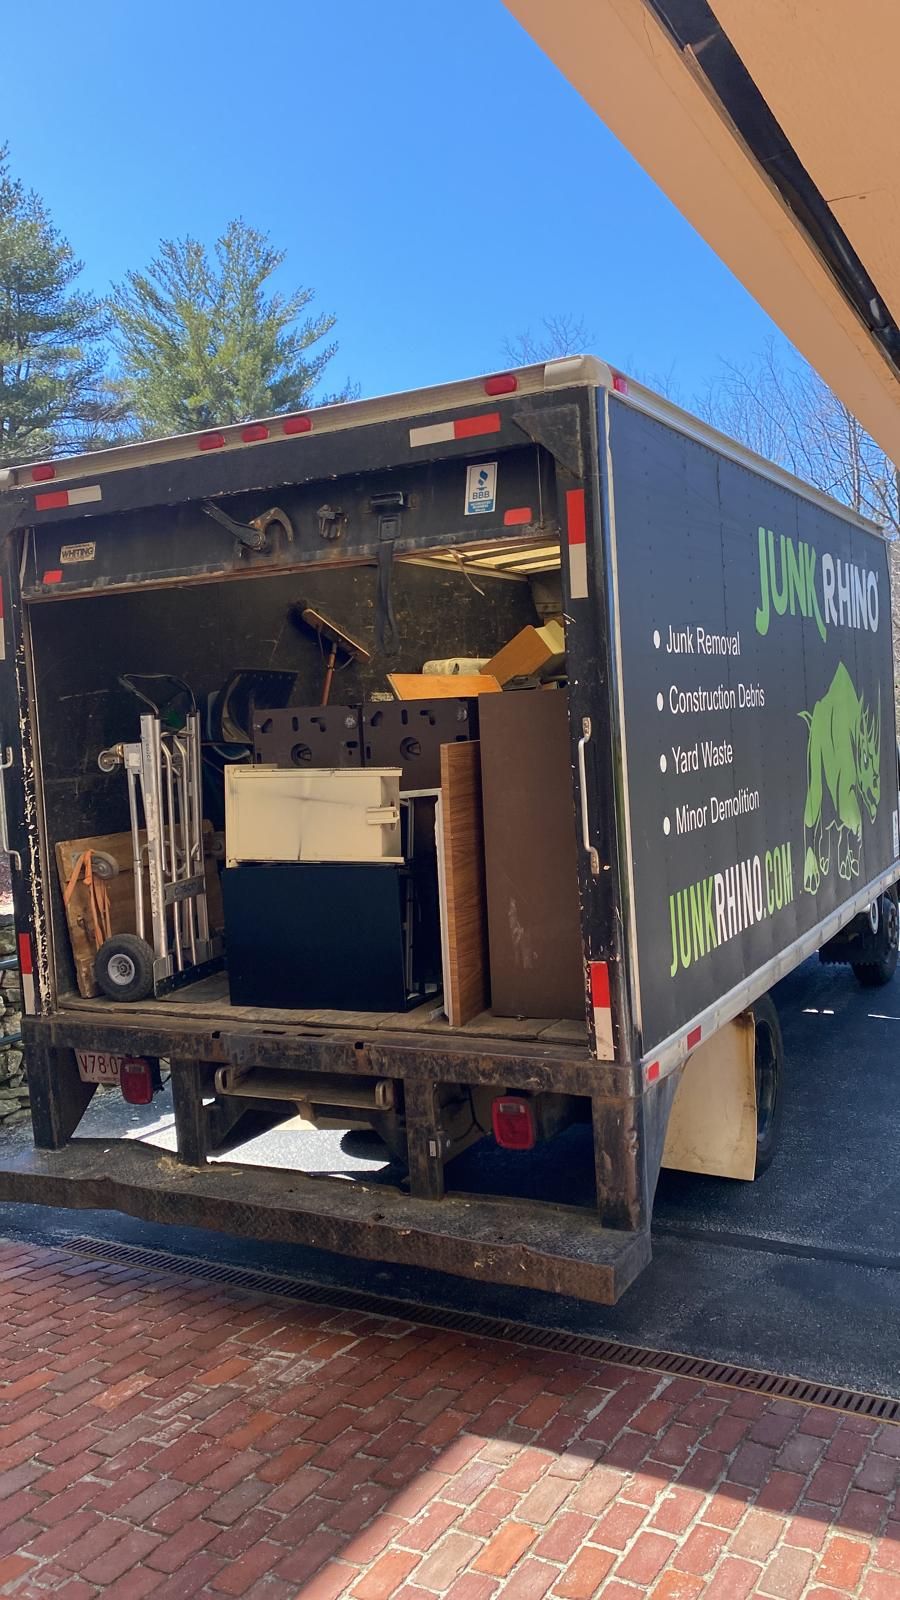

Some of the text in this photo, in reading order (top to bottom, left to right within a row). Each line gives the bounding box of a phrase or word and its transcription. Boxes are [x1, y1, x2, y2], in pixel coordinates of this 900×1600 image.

[61, 547, 94, 559] WHITING
[756, 526, 879, 643] JUNK RHINO
[666, 625, 741, 656] Junk Removal
[669, 683, 765, 714] Construction Debris
[671, 740, 733, 775] Yard Waste
[675, 787, 760, 835] Minor Demolition
[669, 841, 794, 977] JUNKRHINO.COM
